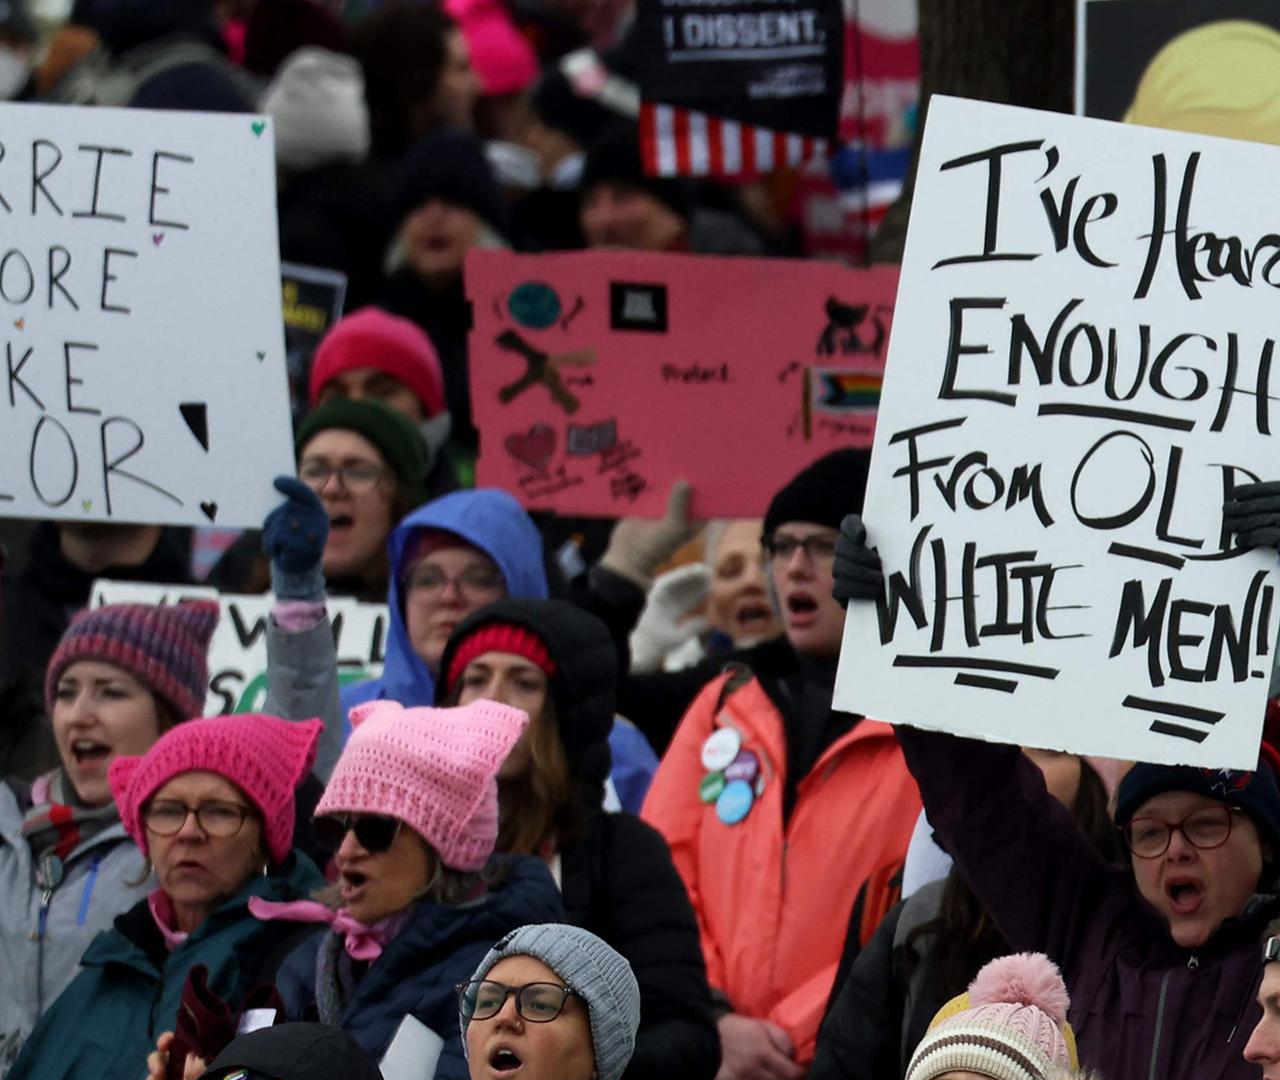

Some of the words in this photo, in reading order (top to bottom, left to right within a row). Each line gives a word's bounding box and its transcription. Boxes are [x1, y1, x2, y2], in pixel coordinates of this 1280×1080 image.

[932, 139, 1119, 271] I've
[889, 417, 1057, 527] From
[875, 525, 1093, 652] WHITE
[1109, 570, 1273, 687] MEN!
